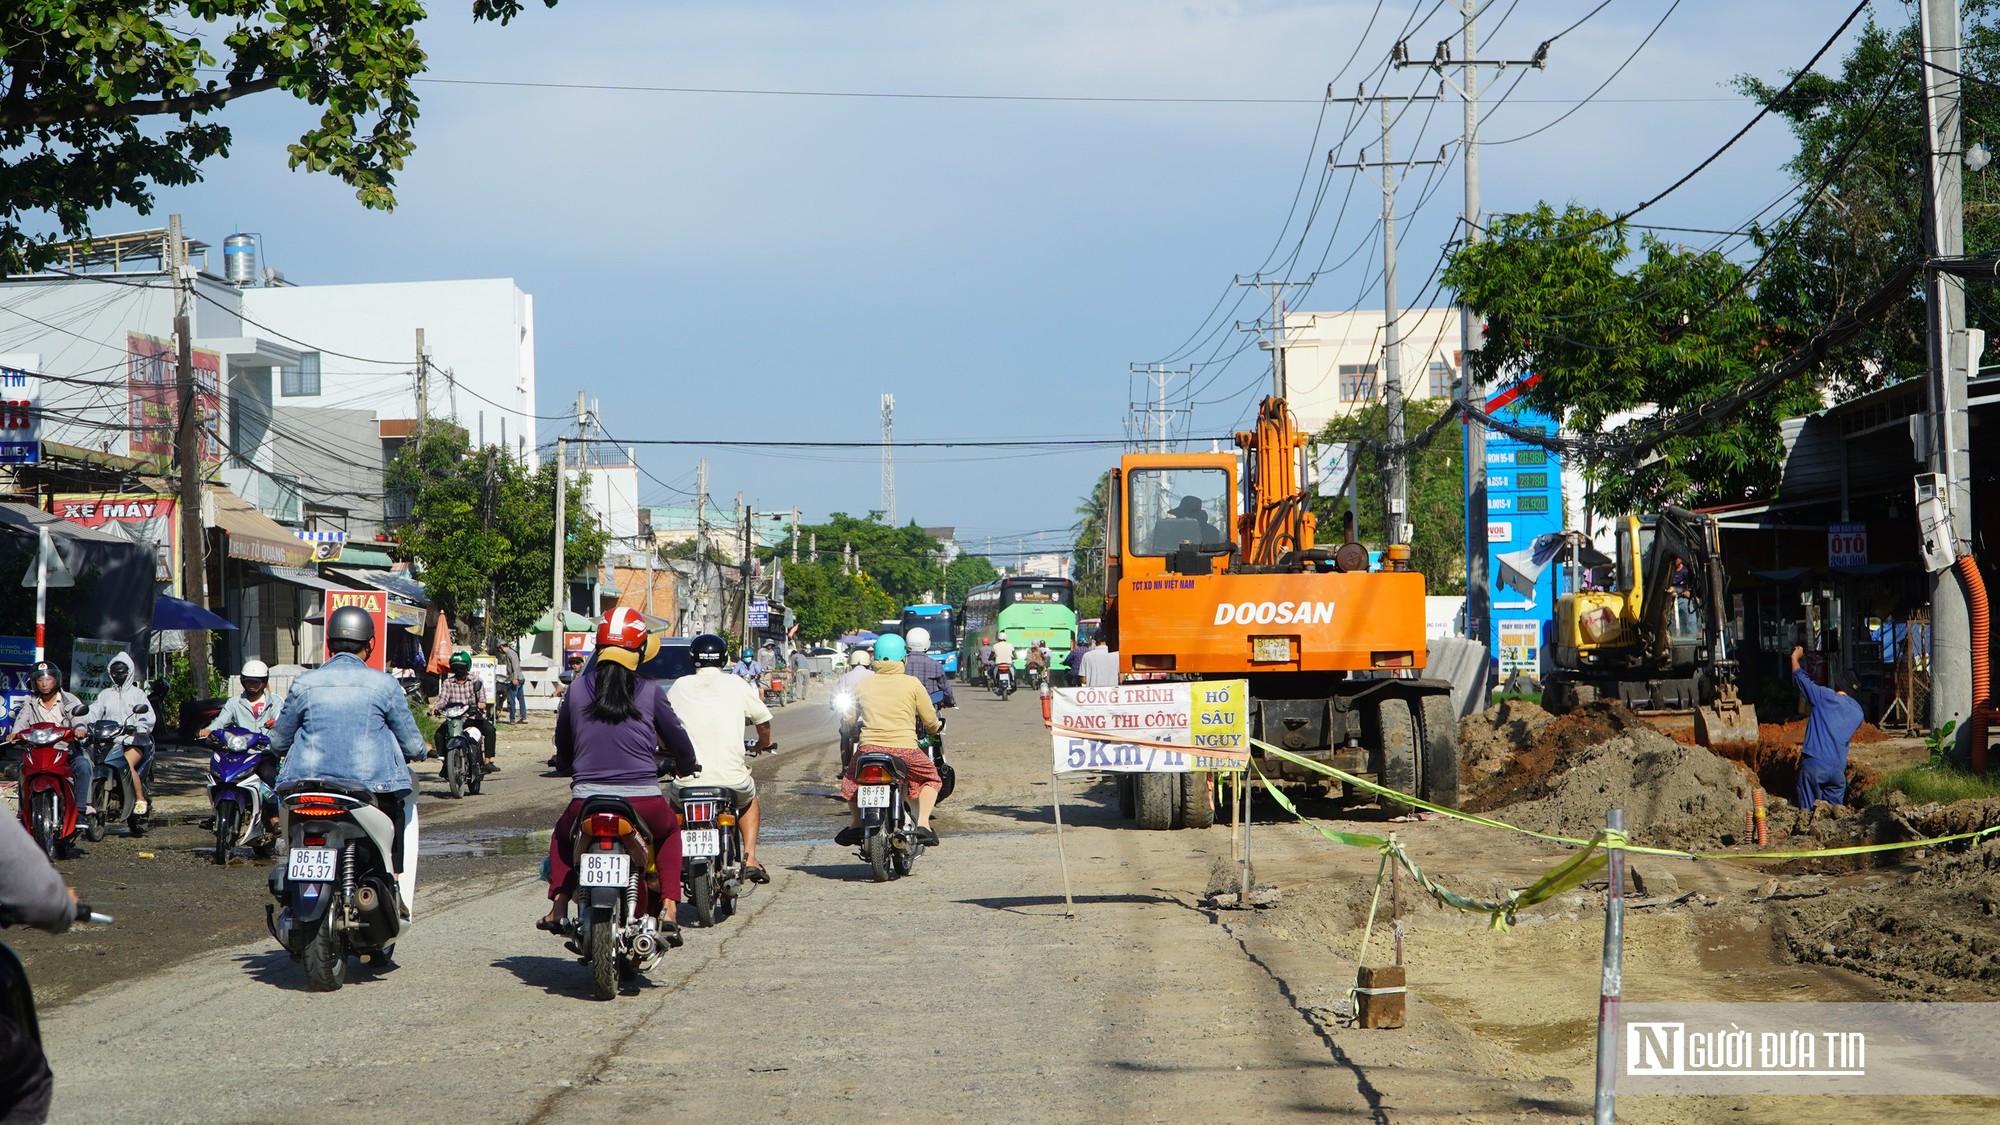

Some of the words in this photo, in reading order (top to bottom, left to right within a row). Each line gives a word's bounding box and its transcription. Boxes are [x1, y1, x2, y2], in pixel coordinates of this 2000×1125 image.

[64, 503, 95, 518] XE
[102, 501, 159, 518] MÁY
[1832, 533, 1864, 553] ÔTÔ
[1132, 581, 1143, 591] TCT
[1154, 580, 1162, 590] NN
[1164, 578, 1178, 591] VIỆT
[1180, 579, 1194, 589] NAM
[331, 593, 381, 612] MUA
[1213, 601, 1335, 625] DOOSAN
[1076, 688, 1119, 704] CÔNG
[1124, 686, 1174, 703] TRÌNH
[1205, 685, 1230, 703] HỐ
[1063, 715, 1106, 729] ĐANG
[1113, 714, 1140, 728] THI
[1144, 710, 1188, 727] CÔNG
[1201, 710, 1235, 724] SÂU
[1194, 734, 1241, 747] NGUY
[861, 796, 885, 806] 6487
[687, 843, 713, 854] 1173
[296, 850, 330, 865] 86-AE
[588, 856, 621, 869] 86-T1
[291, 865, 331, 879] 045.37
[587, 870, 620, 884] 0911
